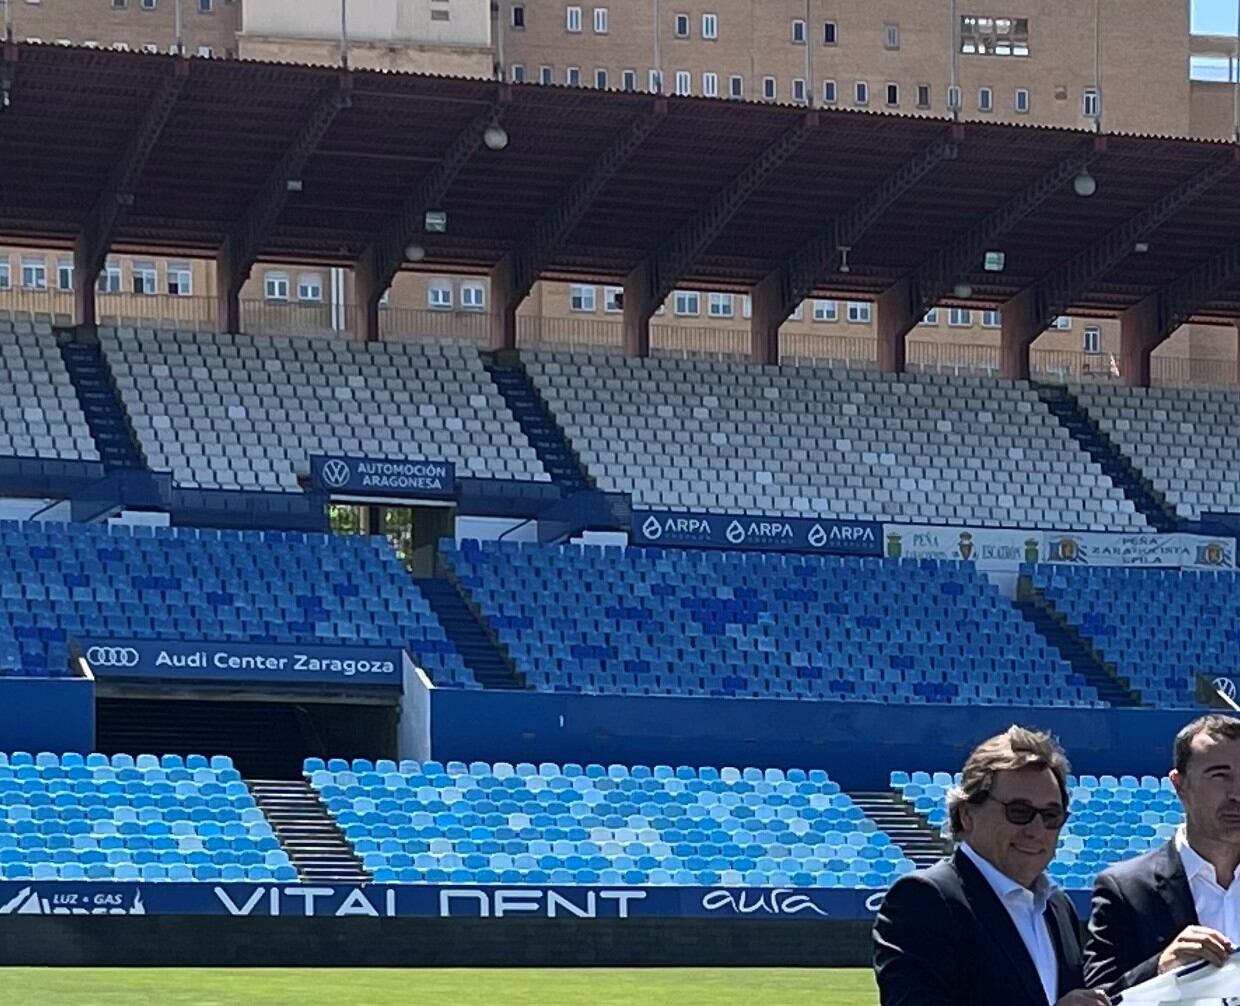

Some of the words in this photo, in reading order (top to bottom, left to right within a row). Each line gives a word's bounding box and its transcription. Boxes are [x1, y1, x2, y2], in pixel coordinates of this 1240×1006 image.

[357, 462, 446, 477] AUTOMOCIÓN
[362, 475, 442, 489] ARAGONESA
[664, 518, 712, 534] ARPA
[747, 522, 794, 537] ARPA
[829, 526, 875, 541] ARPA
[155, 650, 207, 668] Audi
[213, 651, 289, 671] Center
[293, 654, 395, 676] Zaragoza
[53, 893, 79, 905] LUZ
[93, 893, 123, 905] GAS
[702, 888, 829, 916] aura
